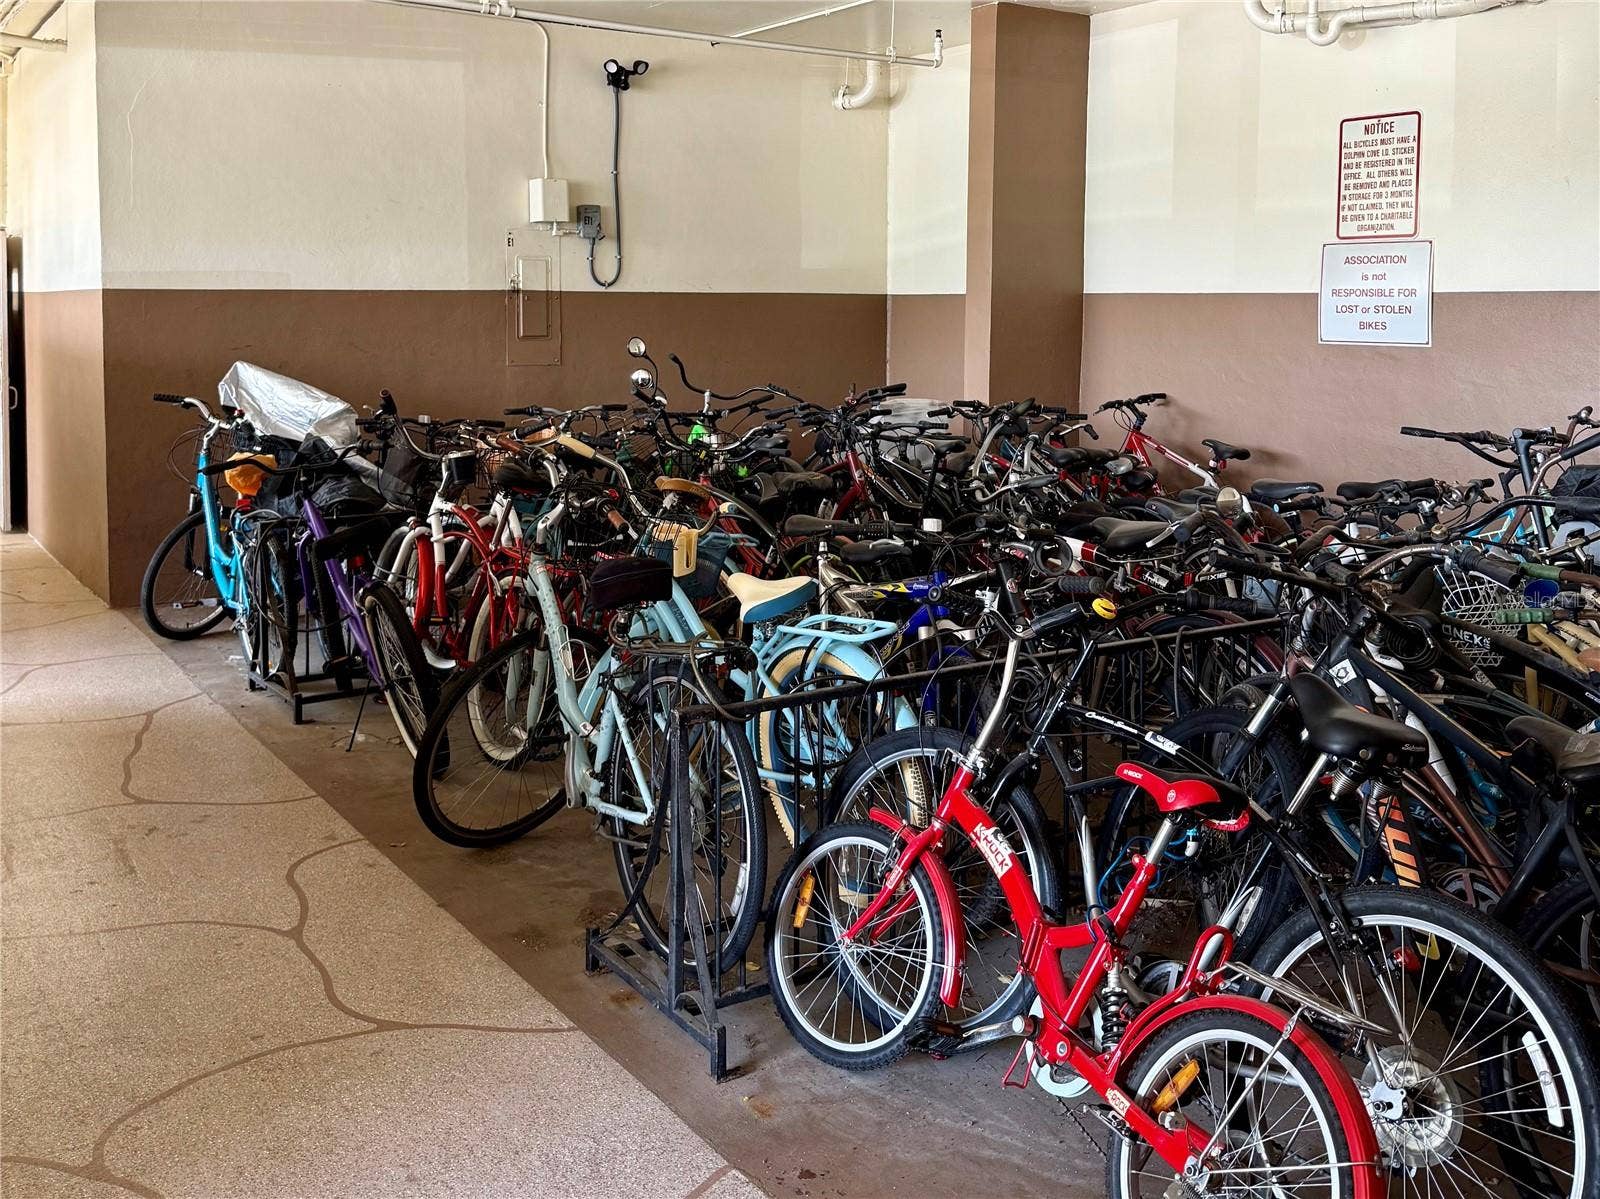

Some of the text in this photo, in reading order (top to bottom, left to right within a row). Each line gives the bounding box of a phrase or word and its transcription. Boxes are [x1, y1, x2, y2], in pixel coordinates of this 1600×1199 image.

[1364, 121, 1395, 136] NOTICE
[1354, 139, 1378, 149] BICYCLES
[1380, 137, 1394, 146] MUST
[1396, 136, 1411, 144] HAVE
[1344, 150, 1365, 160] DOLPHIN
[1366, 149, 1380, 158] COVE
[1392, 146, 1414, 156] STICKER
[1344, 162, 1353, 170] AND
[1355, 161, 1362, 169] BE
[1364, 159, 1395, 168] REGISTERED
[1405, 157, 1414, 165] THE
[1344, 168, 1413, 180] OFFICE. ALL OTHERS WILL
[1353, 182, 1377, 190] REMOVED
[1379, 180, 1390, 188] AND
[1392, 178, 1412, 187] PLACED
[1348, 192, 1371, 201] STORAGE
[1373, 192, 1382, 200] FOR
[1384, 191, 1388, 199] 3
[1341, 204, 1346, 212] IF
[1348, 204, 1358, 212] NOT
[1386, 202, 1398, 210] THEY
[1401, 200, 1413, 208] WILL
[1342, 214, 1348, 222] BE
[1350, 214, 1365, 222] GIVEN
[1366, 213, 1374, 221] TO
[1381, 212, 1412, 220] CHARITABLE
[1344, 255, 1406, 264] ASSOCIATION
[1362, 272, 1386, 280] is not
[1332, 288, 1416, 298] RESPONSIBLE FOR
[1336, 305, 1360, 314] LOST
[1374, 305, 1412, 314] STOLEN
[1359, 322, 1387, 330] BIKES
